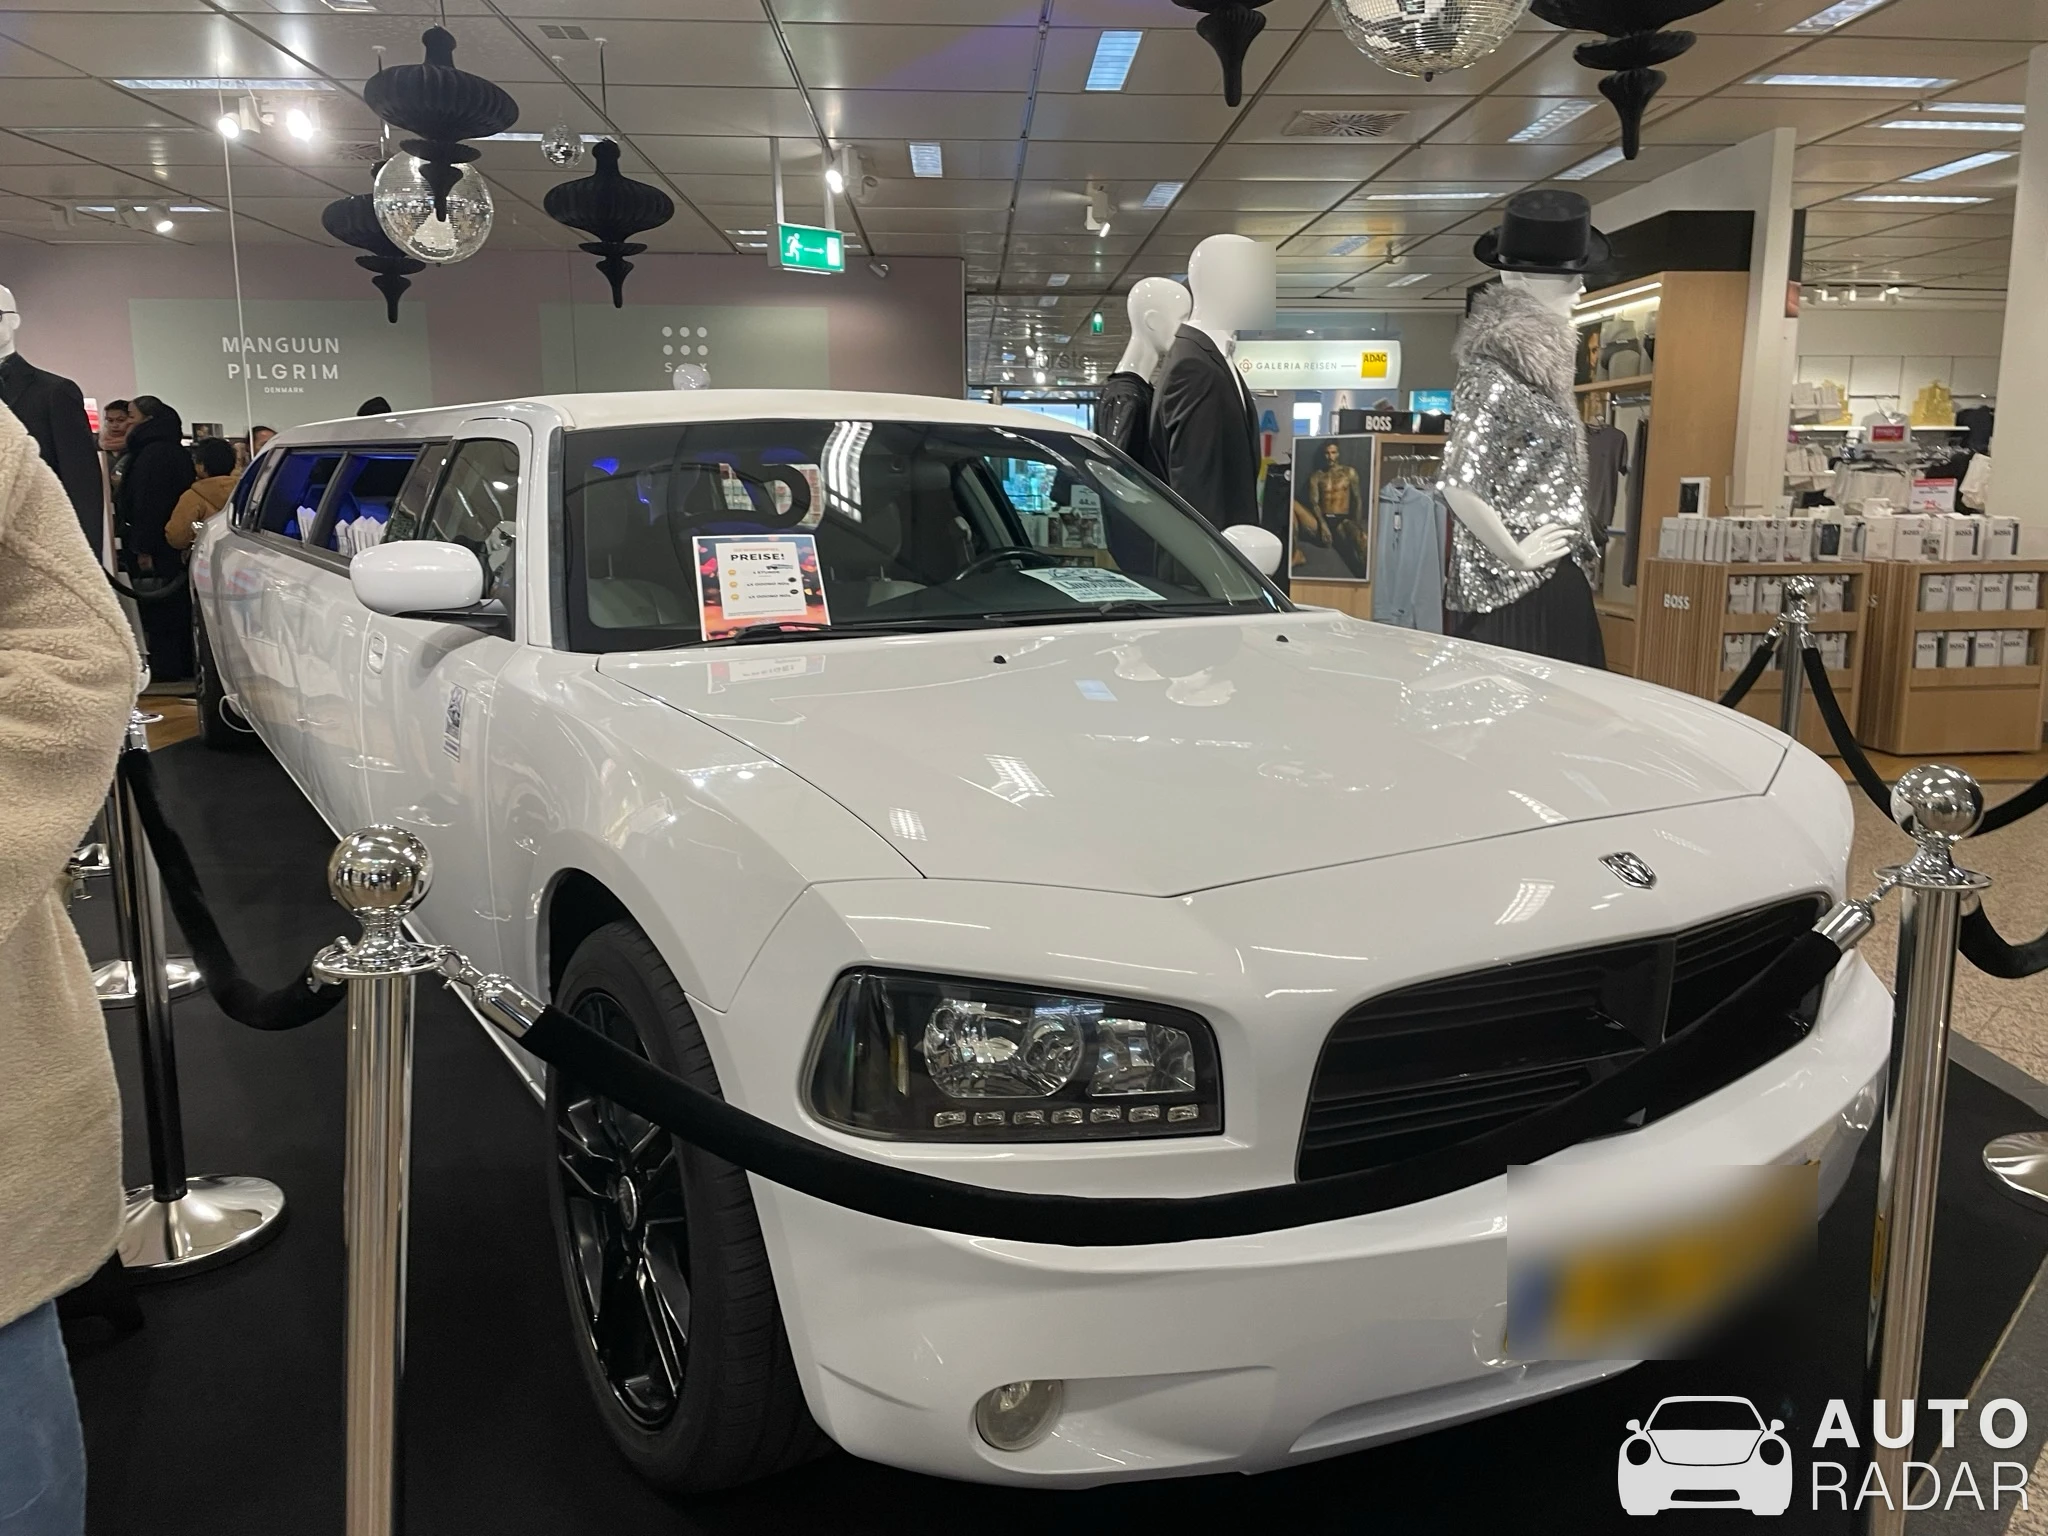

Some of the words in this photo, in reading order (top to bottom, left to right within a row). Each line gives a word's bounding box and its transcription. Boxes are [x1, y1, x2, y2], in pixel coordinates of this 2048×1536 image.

[222, 336, 339, 354] MANGUUN
[1363, 353, 1388, 364] ADAC
[227, 363, 339, 380] PILGRIM
[1256, 362, 1301, 370] GALERIA
[1303, 362, 1337, 370] REISEN
[264, 386, 305, 394] DENMARK
[1365, 414, 1393, 432] BOSS
[730, 553, 785, 561] PREISE!
[1663, 593, 1690, 610] BOSS
